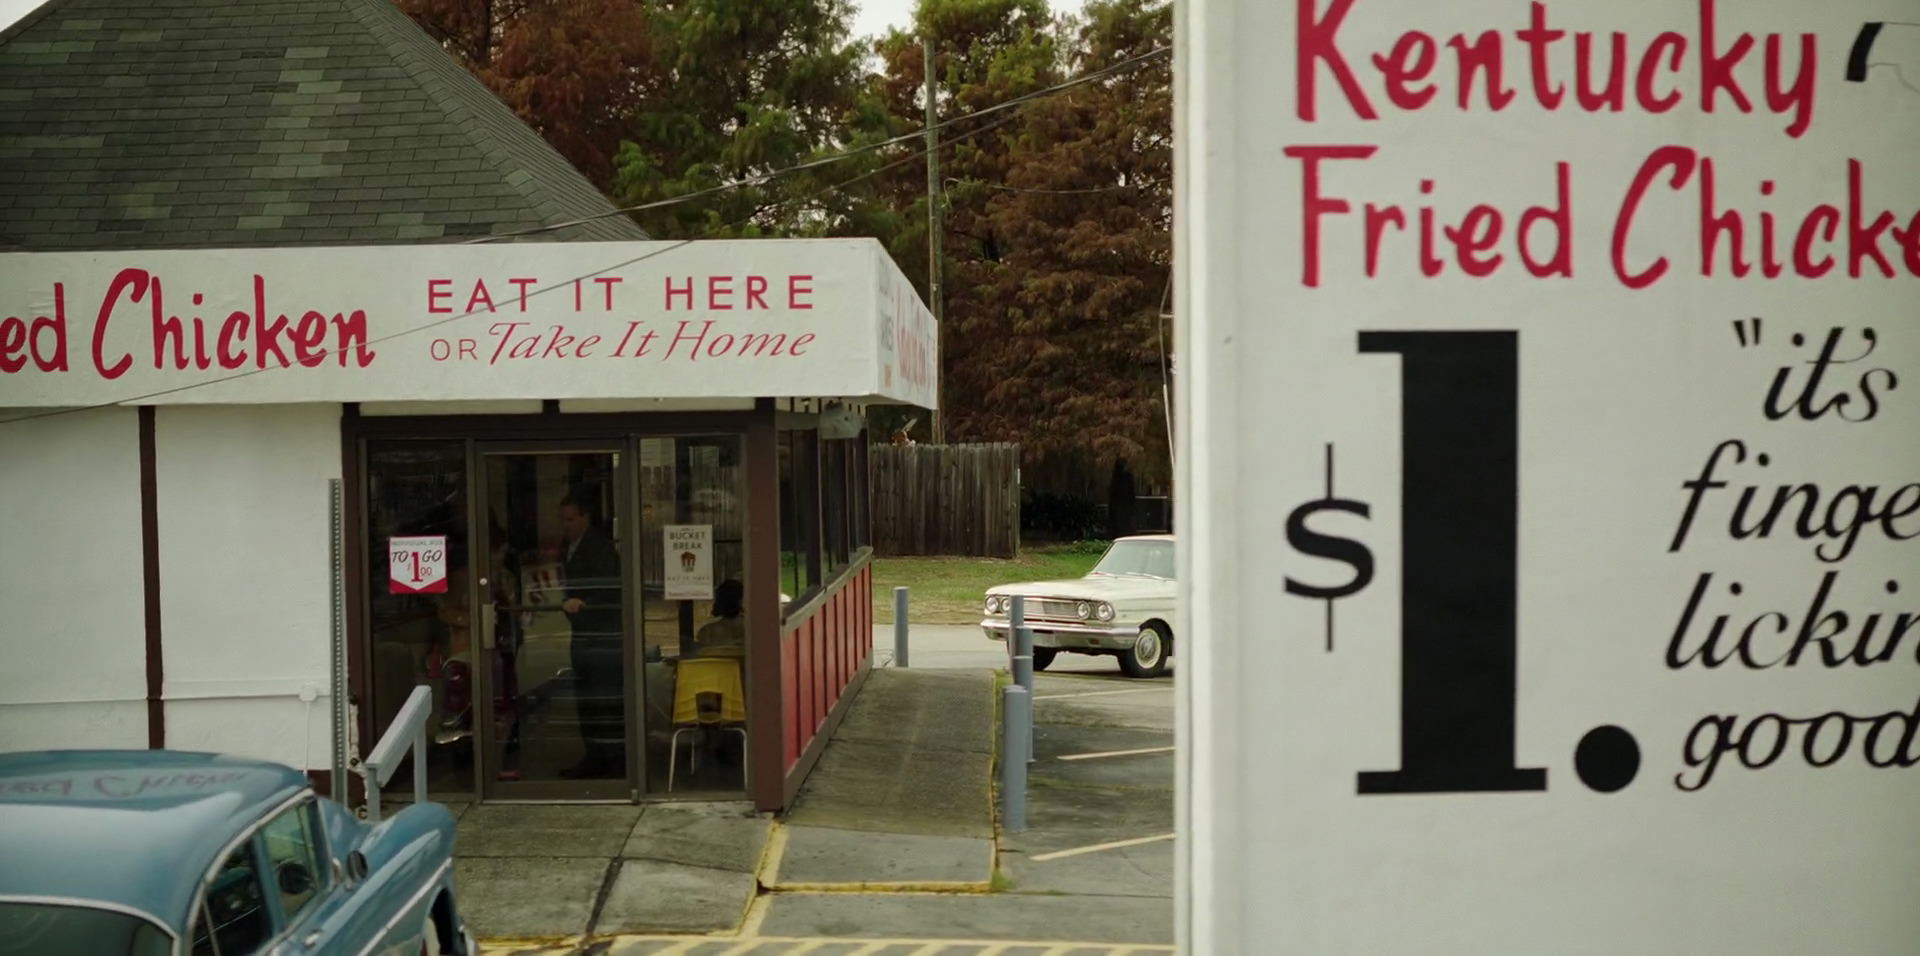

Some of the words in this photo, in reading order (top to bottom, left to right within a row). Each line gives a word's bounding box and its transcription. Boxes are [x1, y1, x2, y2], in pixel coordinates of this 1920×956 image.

[1283, 144, 1575, 289] Fried
[92, 268, 377, 380] Chicken
[427, 278, 538, 313] EAT
[575, 276, 624, 312] IT
[665, 274, 814, 311] HERE
[431, 338, 478, 362] OR
[489, 322, 602, 365] Take
[610, 320, 659, 358] It
[663, 320, 816, 361] Home
[1668, 440, 1920, 563] finge
[392, 550, 408, 563] TO
[422, 549, 442, 563] GO
